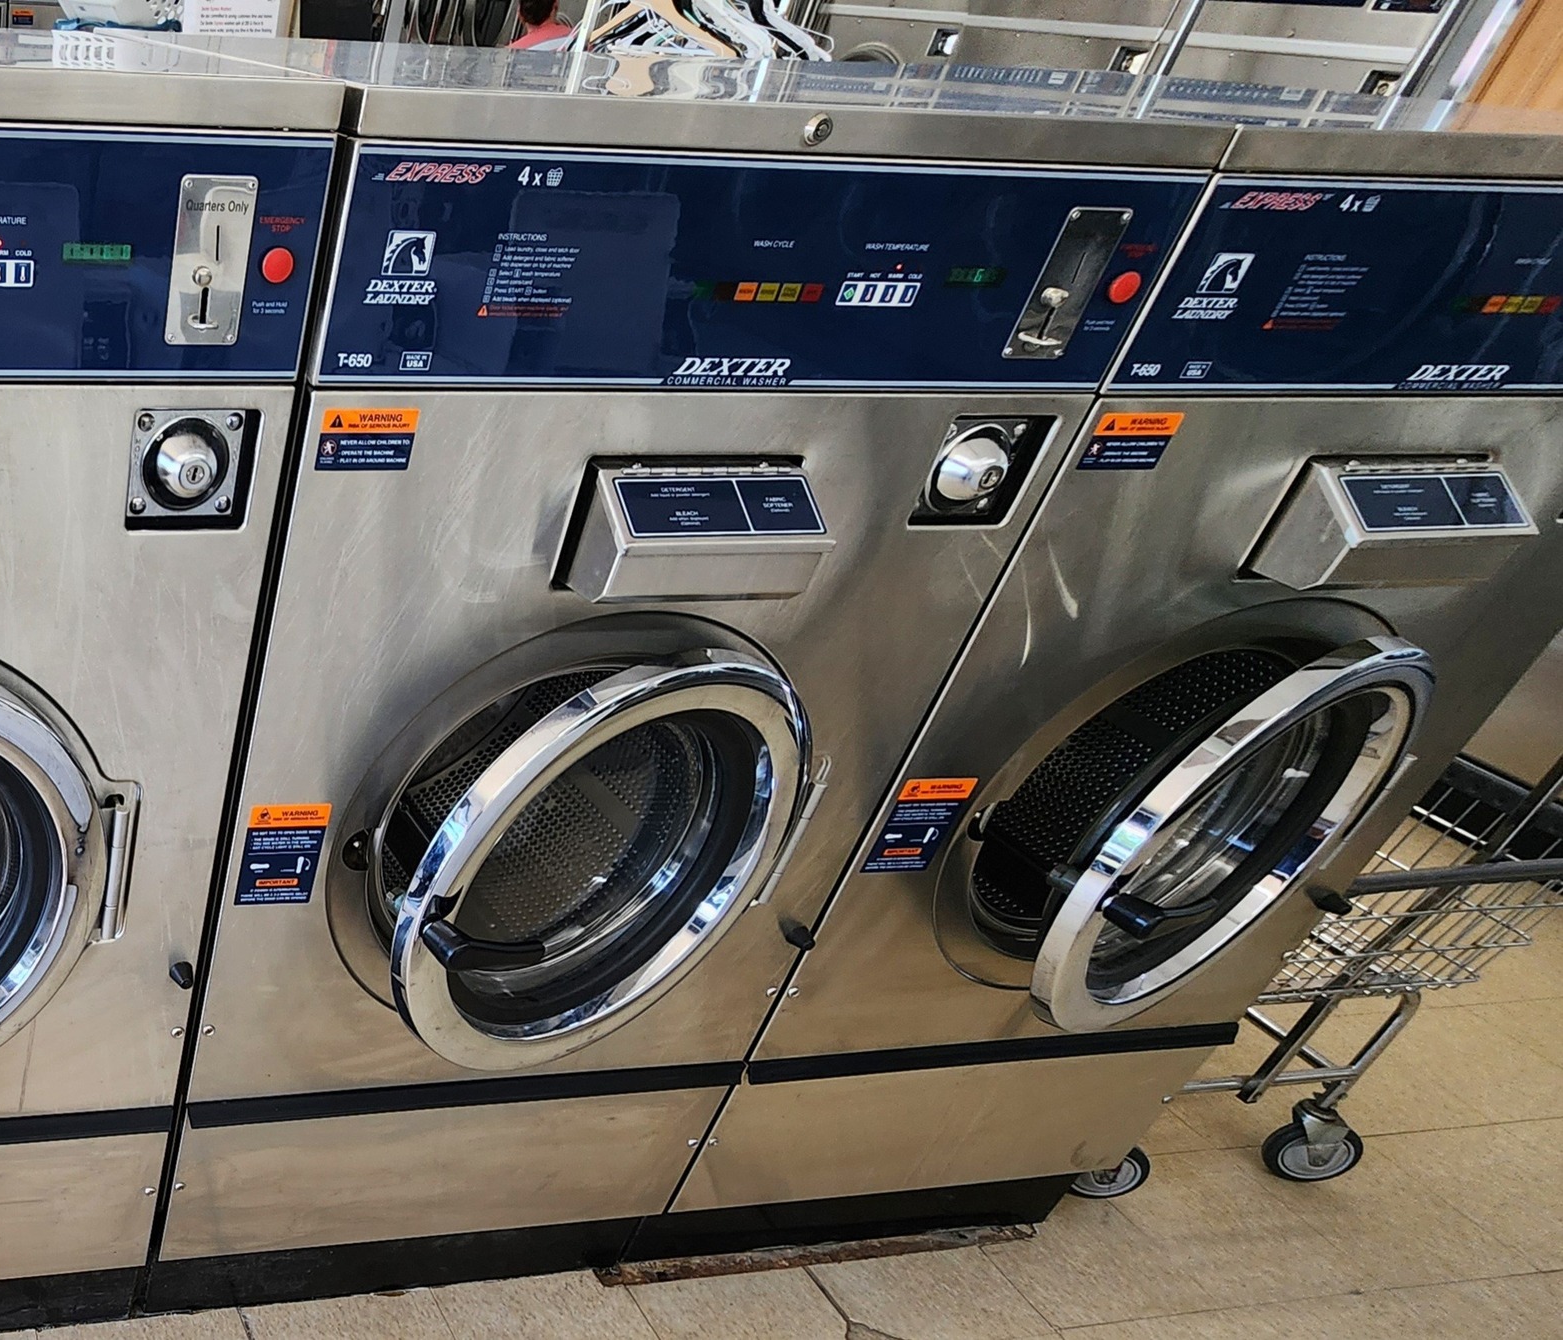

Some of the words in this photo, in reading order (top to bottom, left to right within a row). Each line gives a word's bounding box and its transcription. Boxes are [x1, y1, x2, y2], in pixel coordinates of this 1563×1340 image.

[386, 162, 492, 184] EXPRESS
[517, 166, 531, 186] 4
[1231, 192, 1323, 210] EXPRESS
[1340, 195, 1352, 211] 4
[186, 200, 225, 212] Quarters
[227, 201, 249, 215] Only
[259, 217, 305, 225] EMERGENCY
[498, 233, 547, 241] INSTRUCTIONS
[753, 240, 771, 248] WASH
[772, 240, 795, 248] CYCLE
[865, 243, 886, 252] WASH
[886, 243, 930, 252] TEMPERATURE
[15, 249, 32, 257] COLD
[366, 280, 435, 292] DEXTER
[363, 294, 435, 305] LAUNDRY
[1179, 297, 1237, 309] DEXTER
[1172, 310, 1233, 320] LAUNDRY
[337, 354, 372, 367] T-650
[406, 360, 423, 368] USA
[673, 358, 791, 376] DEXTER
[1131, 364, 1161, 376] T-650
[1406, 365, 1510, 381] DEXTER
[667, 377, 737, 385] COMMERCIAL
[742, 377, 786, 385] WASHER
[359, 414, 403, 422] WARNING
